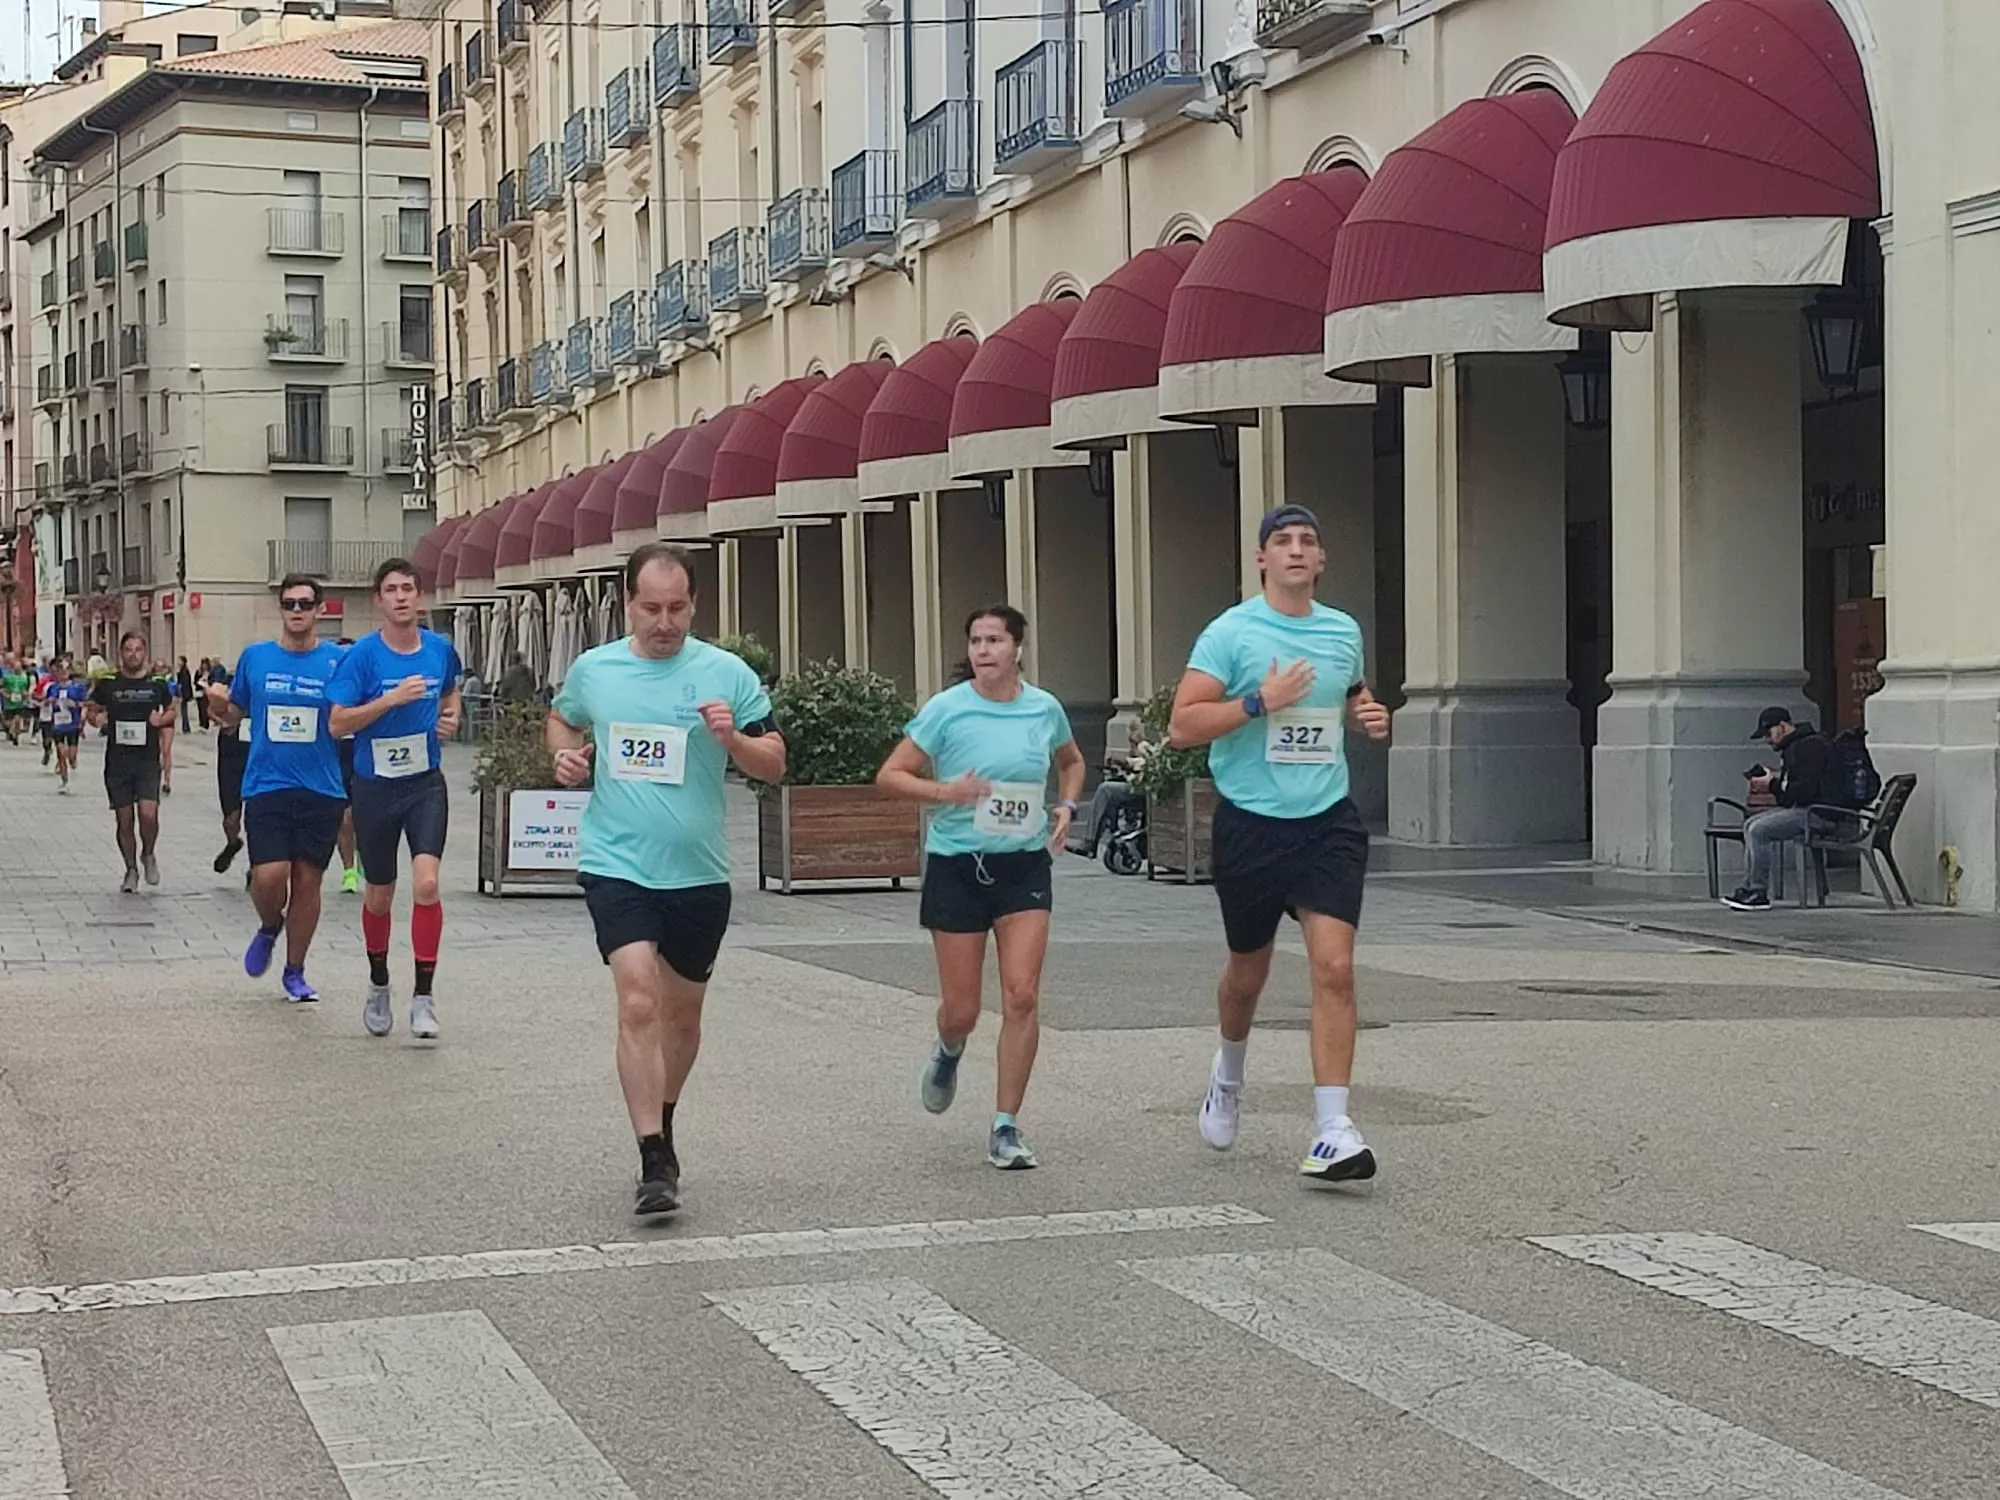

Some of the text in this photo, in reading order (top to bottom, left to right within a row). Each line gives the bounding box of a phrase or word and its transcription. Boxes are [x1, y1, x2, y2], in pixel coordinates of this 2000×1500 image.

[411, 384, 427, 490] HOSTAL
[1280, 726, 1324, 744] 327
[387, 747, 411, 762] 22
[621, 738, 666, 759] 328
[989, 798, 1029, 819] 329
